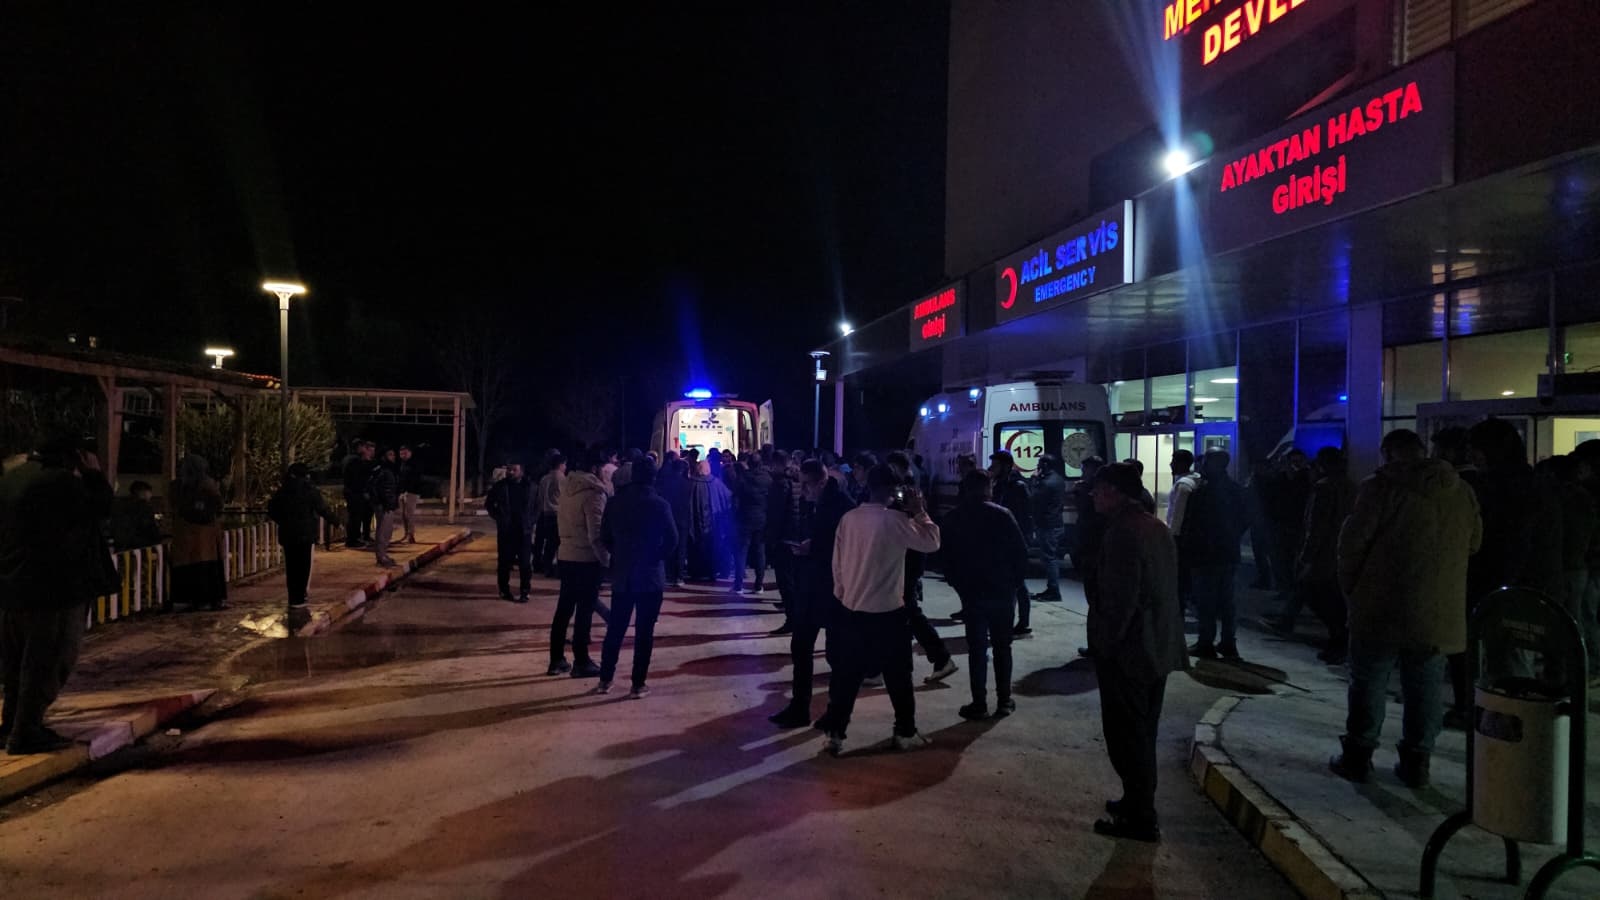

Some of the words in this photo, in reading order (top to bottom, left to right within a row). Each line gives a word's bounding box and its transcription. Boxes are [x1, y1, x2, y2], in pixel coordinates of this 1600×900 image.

[1202, 0, 1306, 66] DEVL
[1220, 124, 1321, 193] AYAKTAN
[1327, 81, 1424, 149] HASTA
[1271, 154, 1347, 215] GİRİŞİ
[1020, 248, 1053, 285] ACİL
[1034, 266, 1096, 303] EMERGENCY
[1009, 401, 1087, 412] AMBULANS
[1014, 445, 1043, 458] 112
